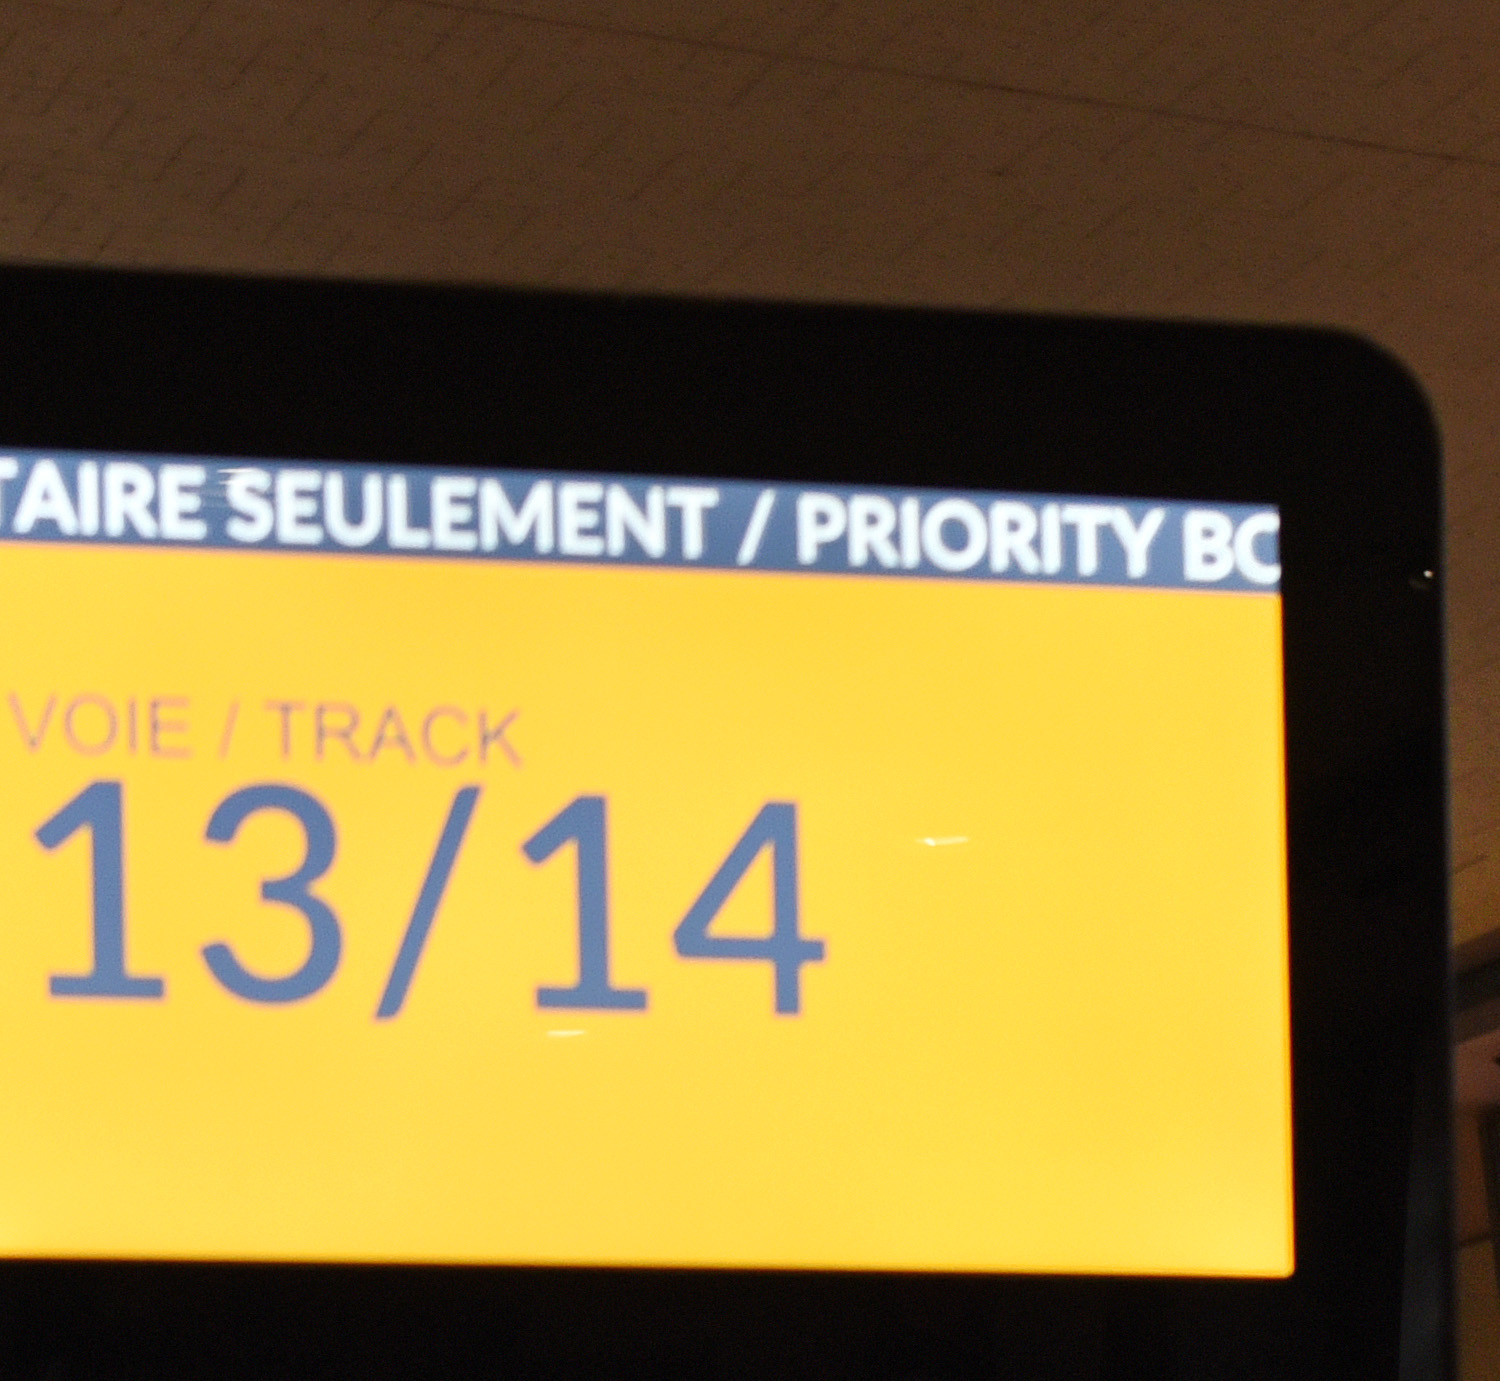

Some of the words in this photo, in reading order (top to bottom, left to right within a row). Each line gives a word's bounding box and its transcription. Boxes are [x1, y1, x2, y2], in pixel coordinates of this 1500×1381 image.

[225, 468, 720, 560] SEULEMENT
[736, 488, 776, 566] /
[797, 492, 1167, 578] PRIORITY
[4, 690, 197, 762] VOIE
[274, 698, 526, 770] TRACK
[31, 777, 829, 1023] 13/14
